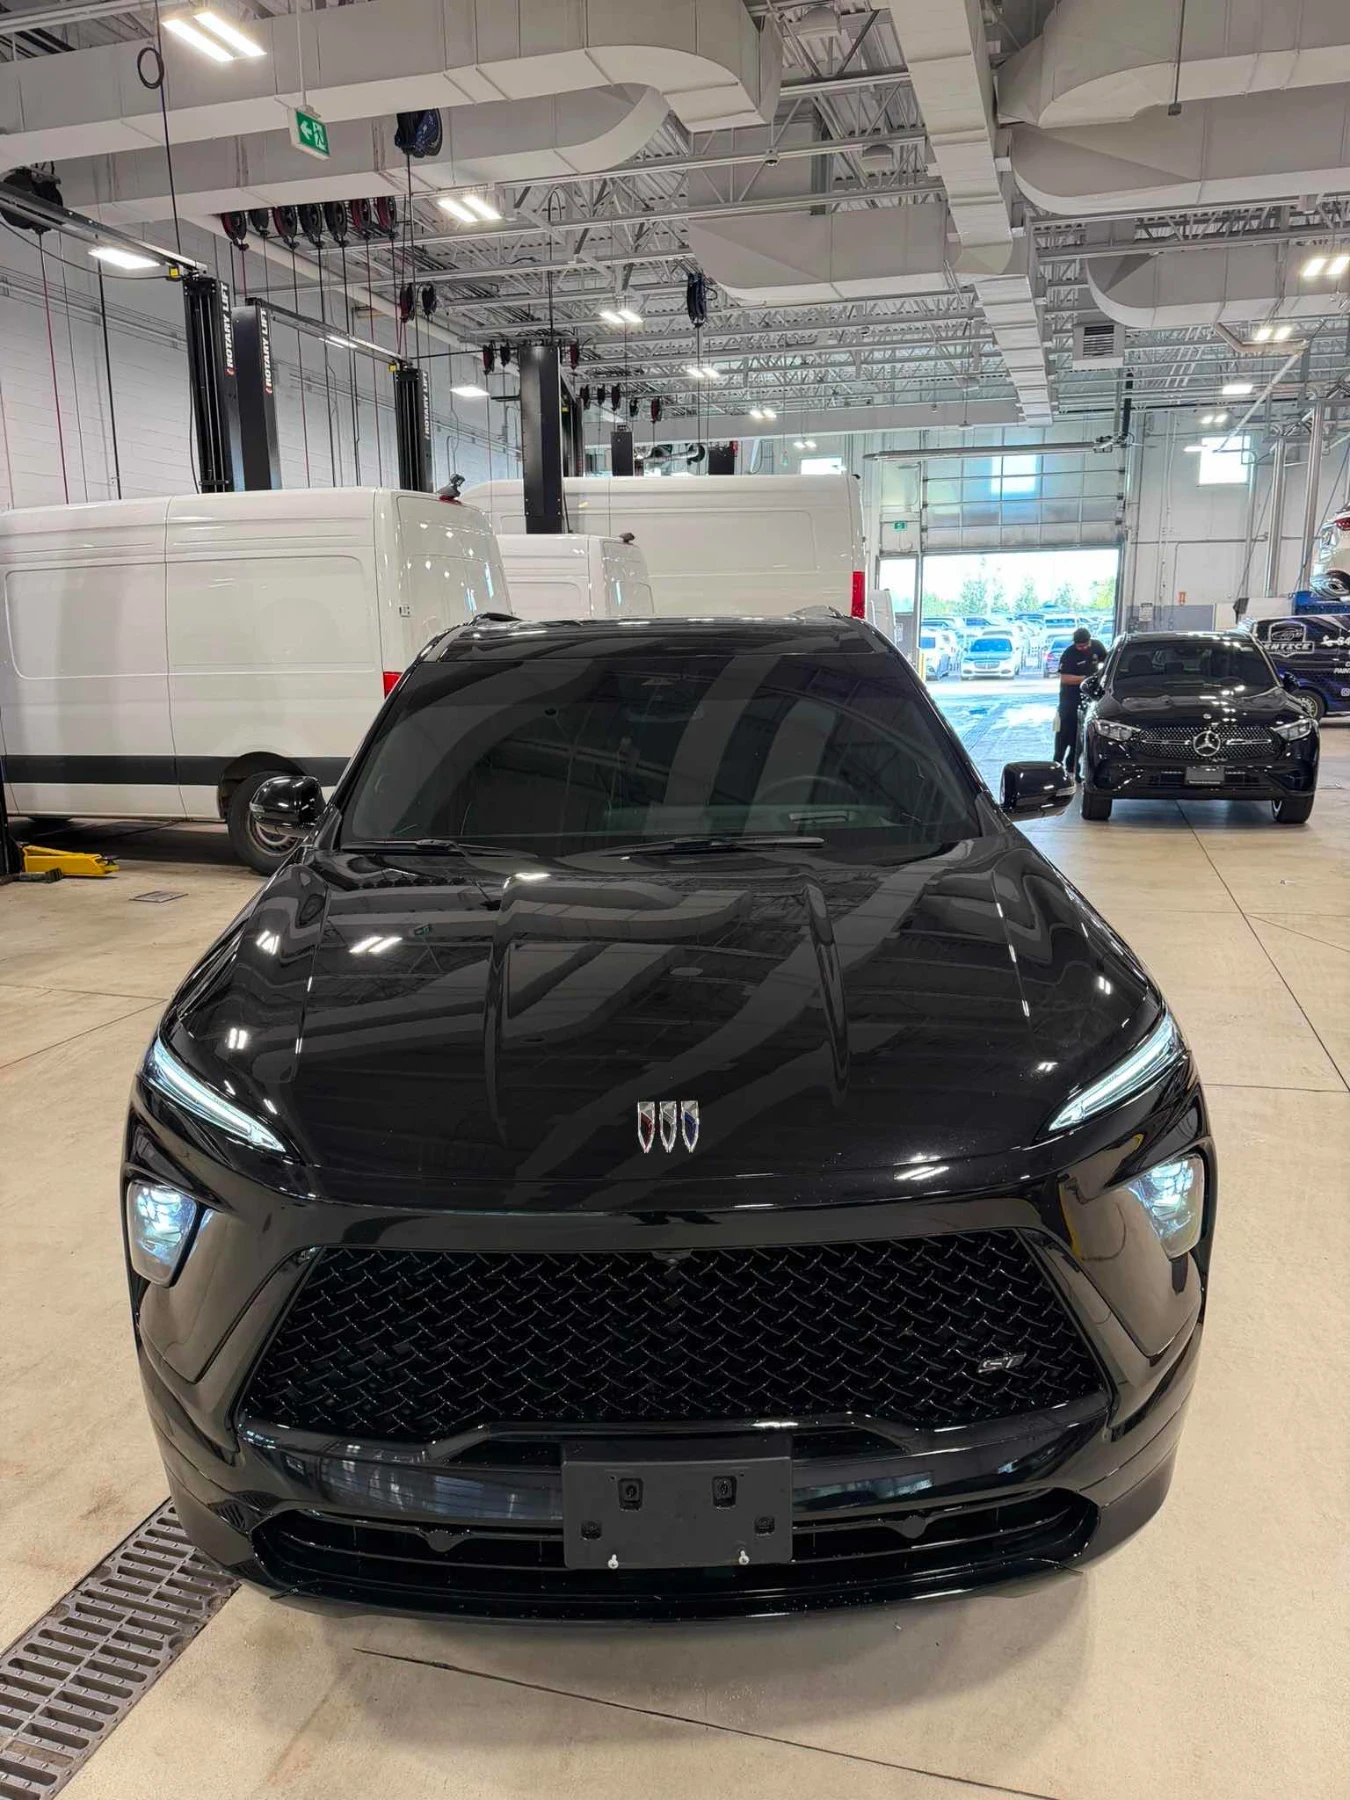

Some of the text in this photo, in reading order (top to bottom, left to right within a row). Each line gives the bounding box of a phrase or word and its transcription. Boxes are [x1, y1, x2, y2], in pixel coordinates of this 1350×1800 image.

[220, 282, 234, 368] ROTARY LIFT
[260, 308, 272, 387] ROTARY LIFT
